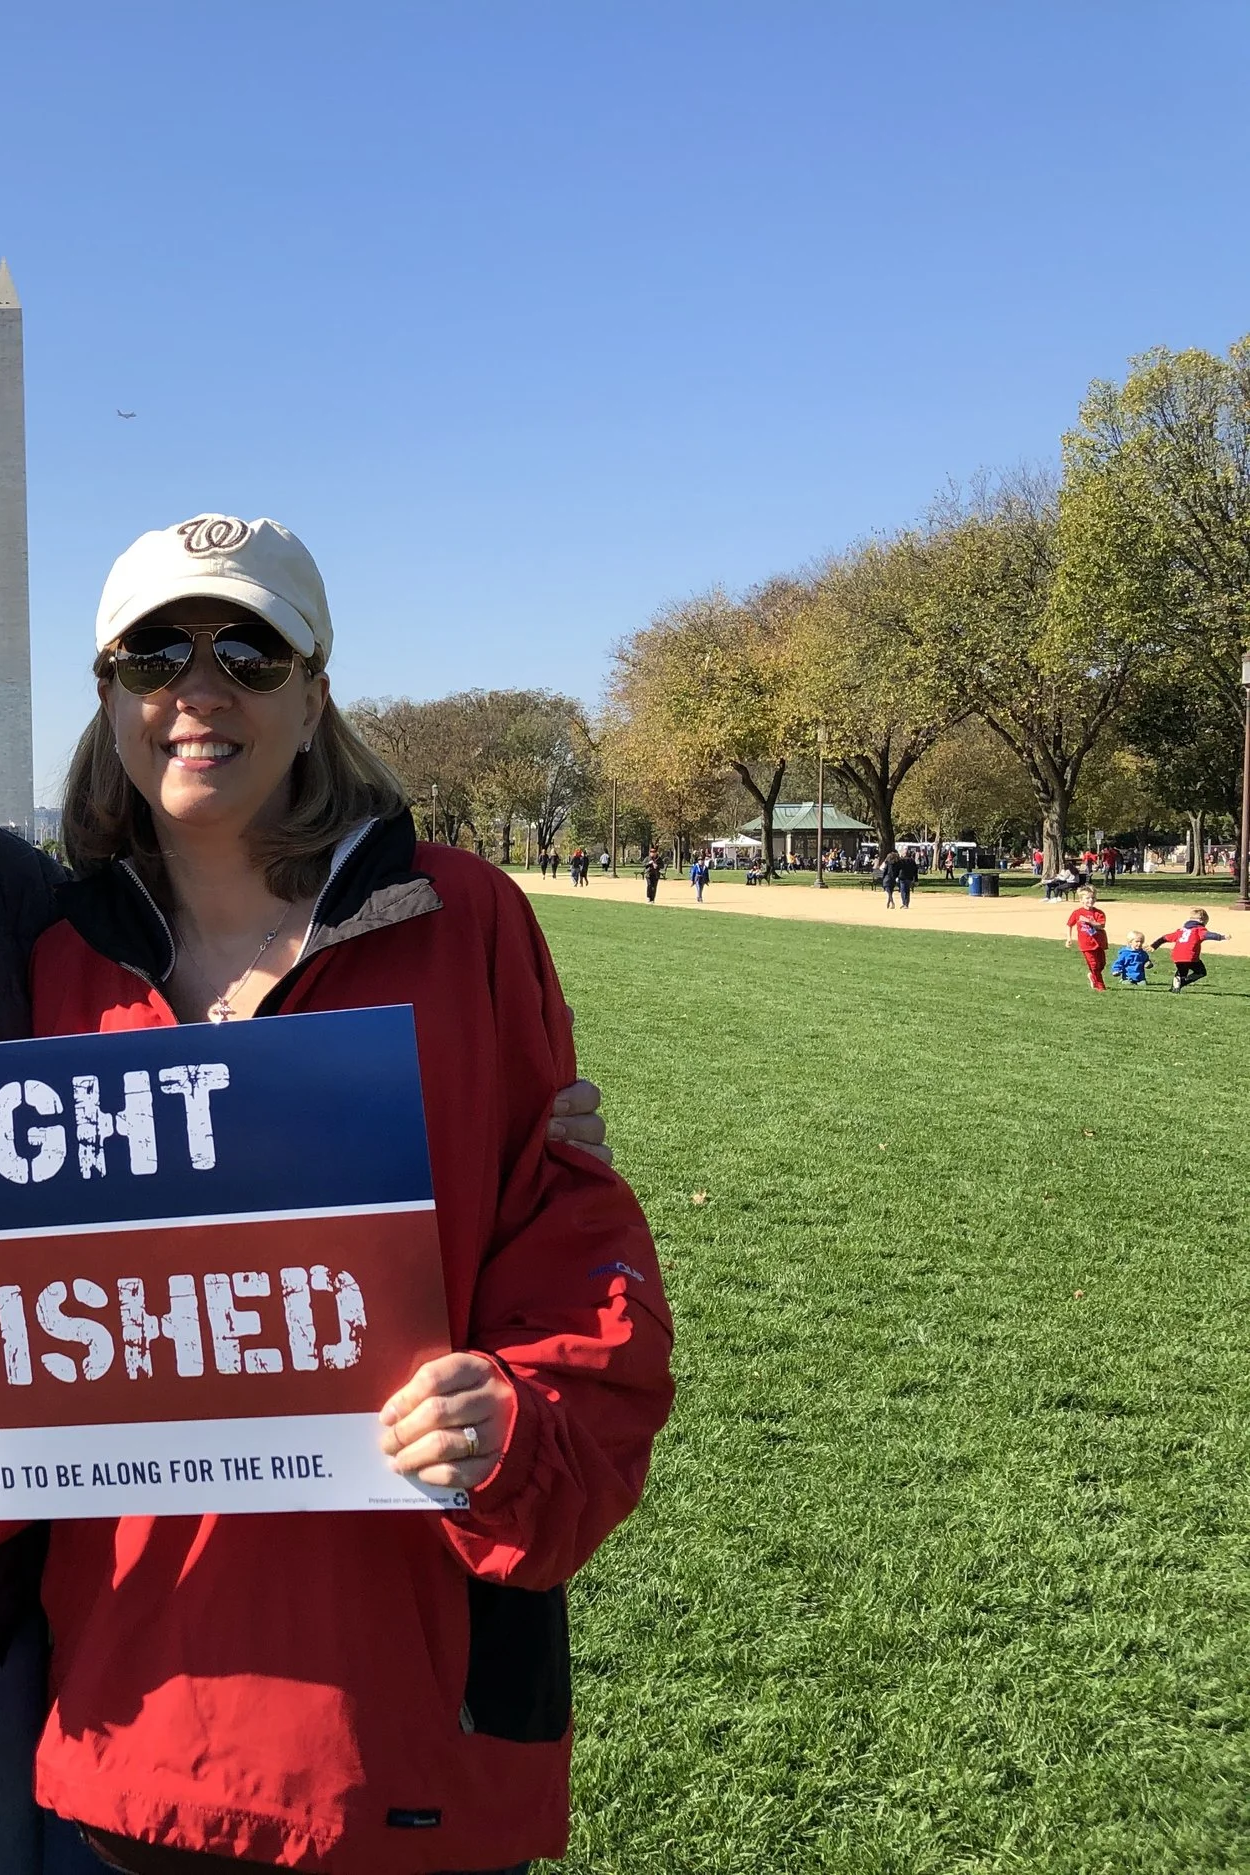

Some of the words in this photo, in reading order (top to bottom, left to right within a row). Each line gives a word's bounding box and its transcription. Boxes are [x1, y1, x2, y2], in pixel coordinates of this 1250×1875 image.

[176, 518, 249, 553] W
[21, 1465, 49, 1489] TO
[55, 1464, 85, 1488] BE
[92, 1461, 162, 1487] ALONG
[169, 1459, 215, 1483] FOR
[220, 1457, 264, 1482] THE
[271, 1454, 333, 1480] RIDE.
